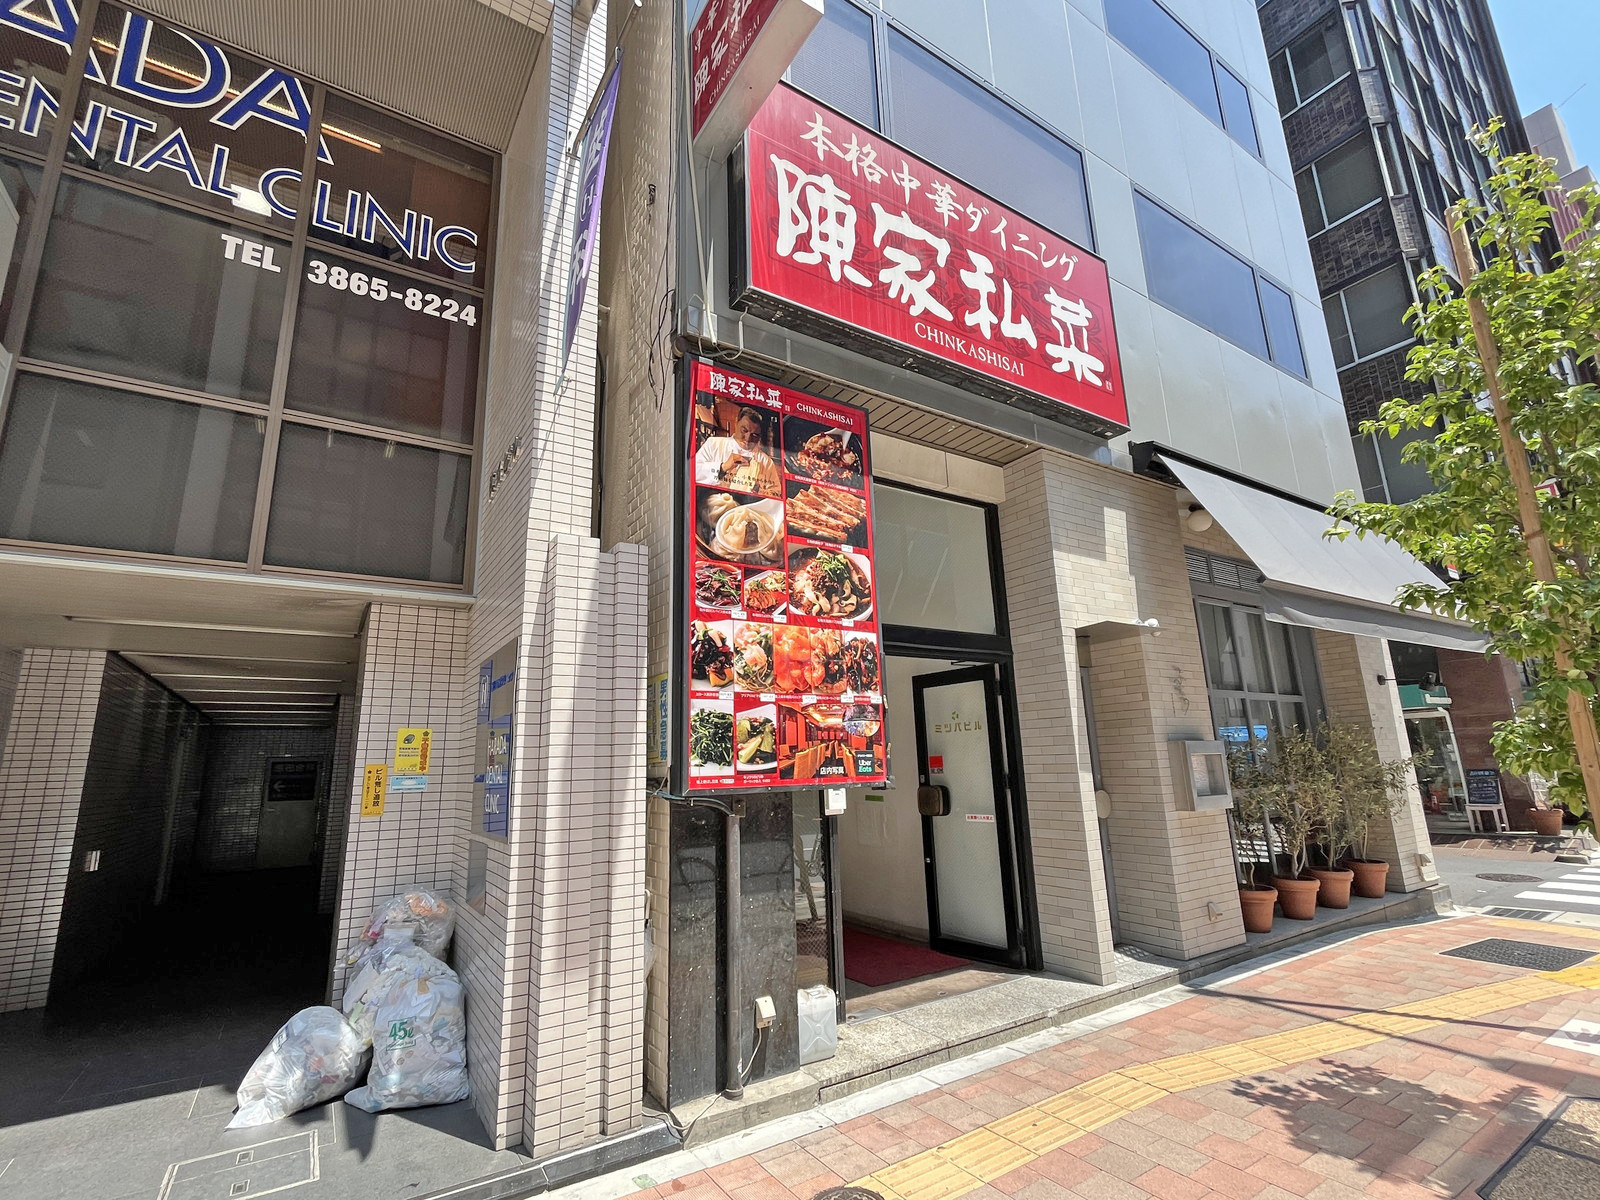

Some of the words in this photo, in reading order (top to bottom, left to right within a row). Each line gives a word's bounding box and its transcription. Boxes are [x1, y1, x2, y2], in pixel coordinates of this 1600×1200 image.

[258, 168, 479, 273] CLINIC
[800, 112, 1079, 282] 本格中華ダイニング
[221, 235, 281, 273] TEL
[308, 260, 477, 327] 3865-8224
[770, 153, 1105, 387] 陳家私菜
[914, 322, 1025, 377] CHINKASHISAI
[709, 371, 783, 409] 陳家私菜
[796, 402, 853, 426] CHINKASHISAI
[935, 721, 982, 733] ミツバビル
